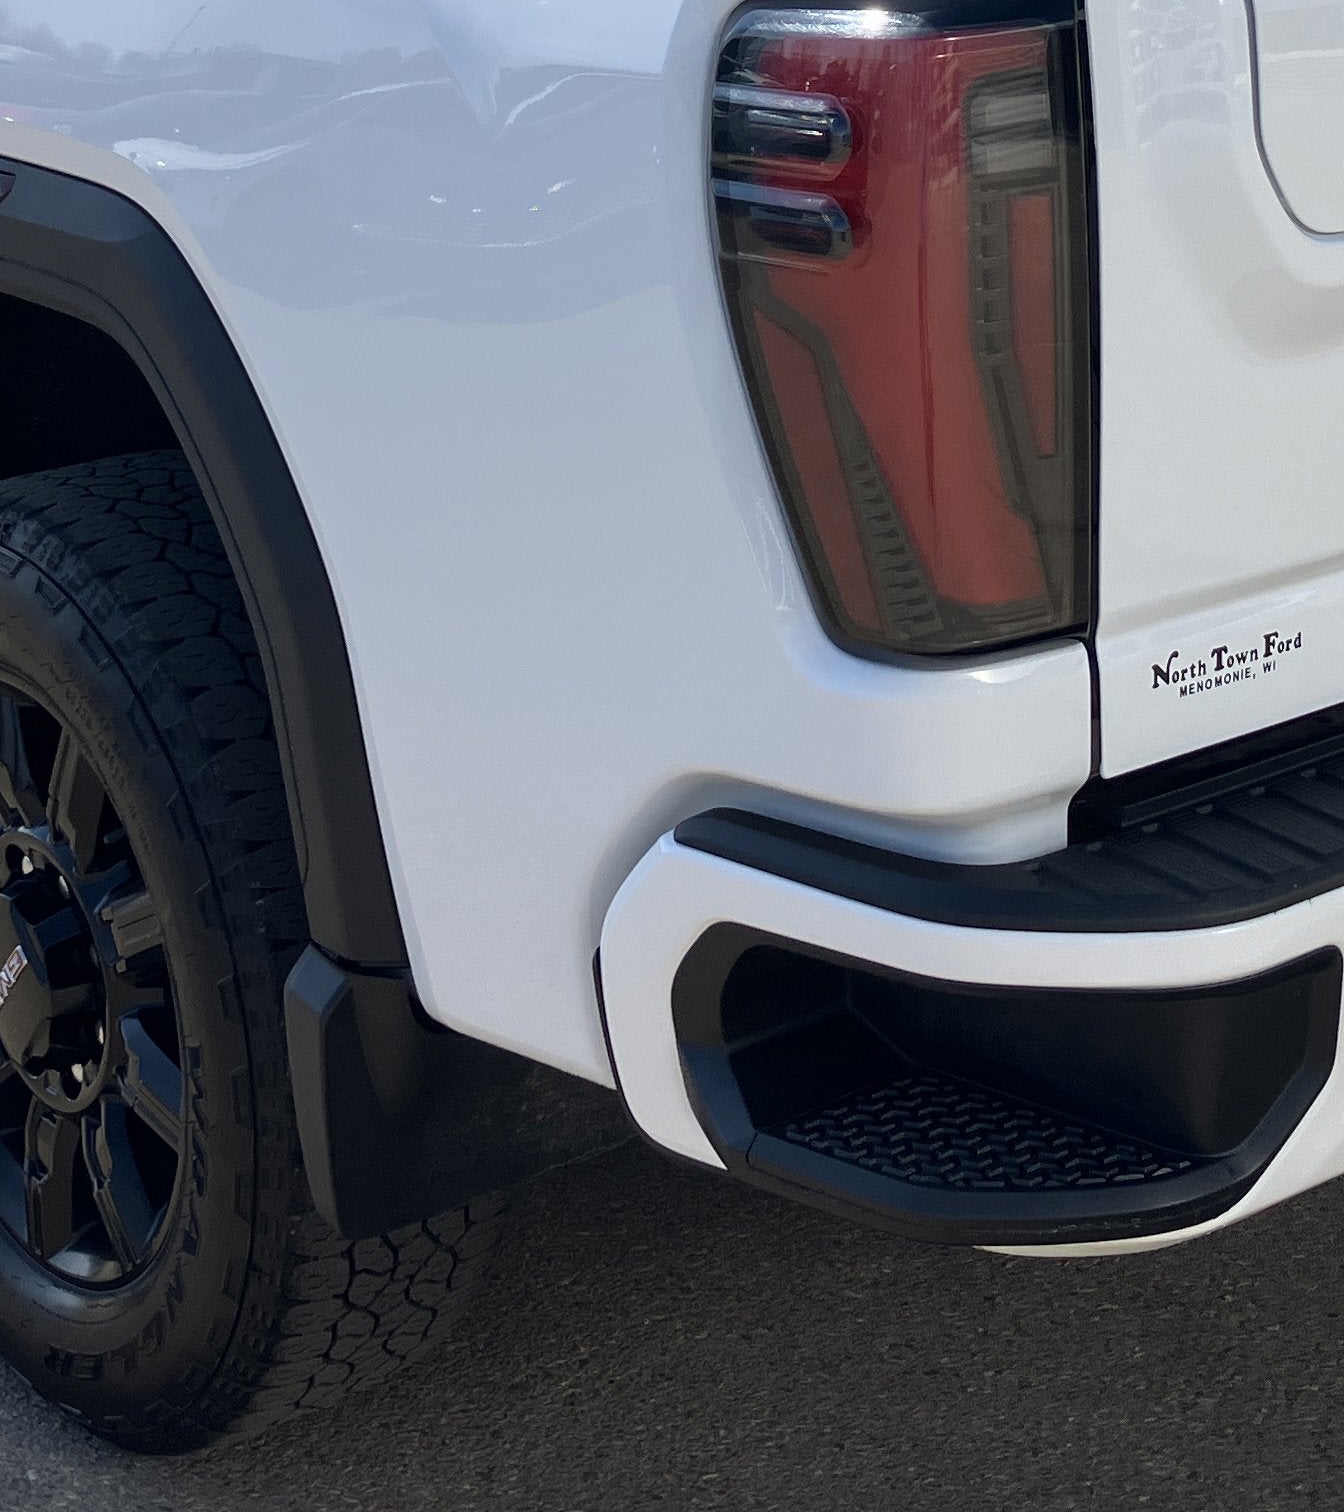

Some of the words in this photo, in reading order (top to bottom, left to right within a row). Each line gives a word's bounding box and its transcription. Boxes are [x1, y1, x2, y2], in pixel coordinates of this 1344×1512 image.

[1151, 650, 1207, 689] North
[1210, 645, 1259, 672] Town
[1262, 631, 1303, 658] Ford
[1179, 666, 1257, 698] MENOMONIE,
[1262, 660, 1276, 674] WI
